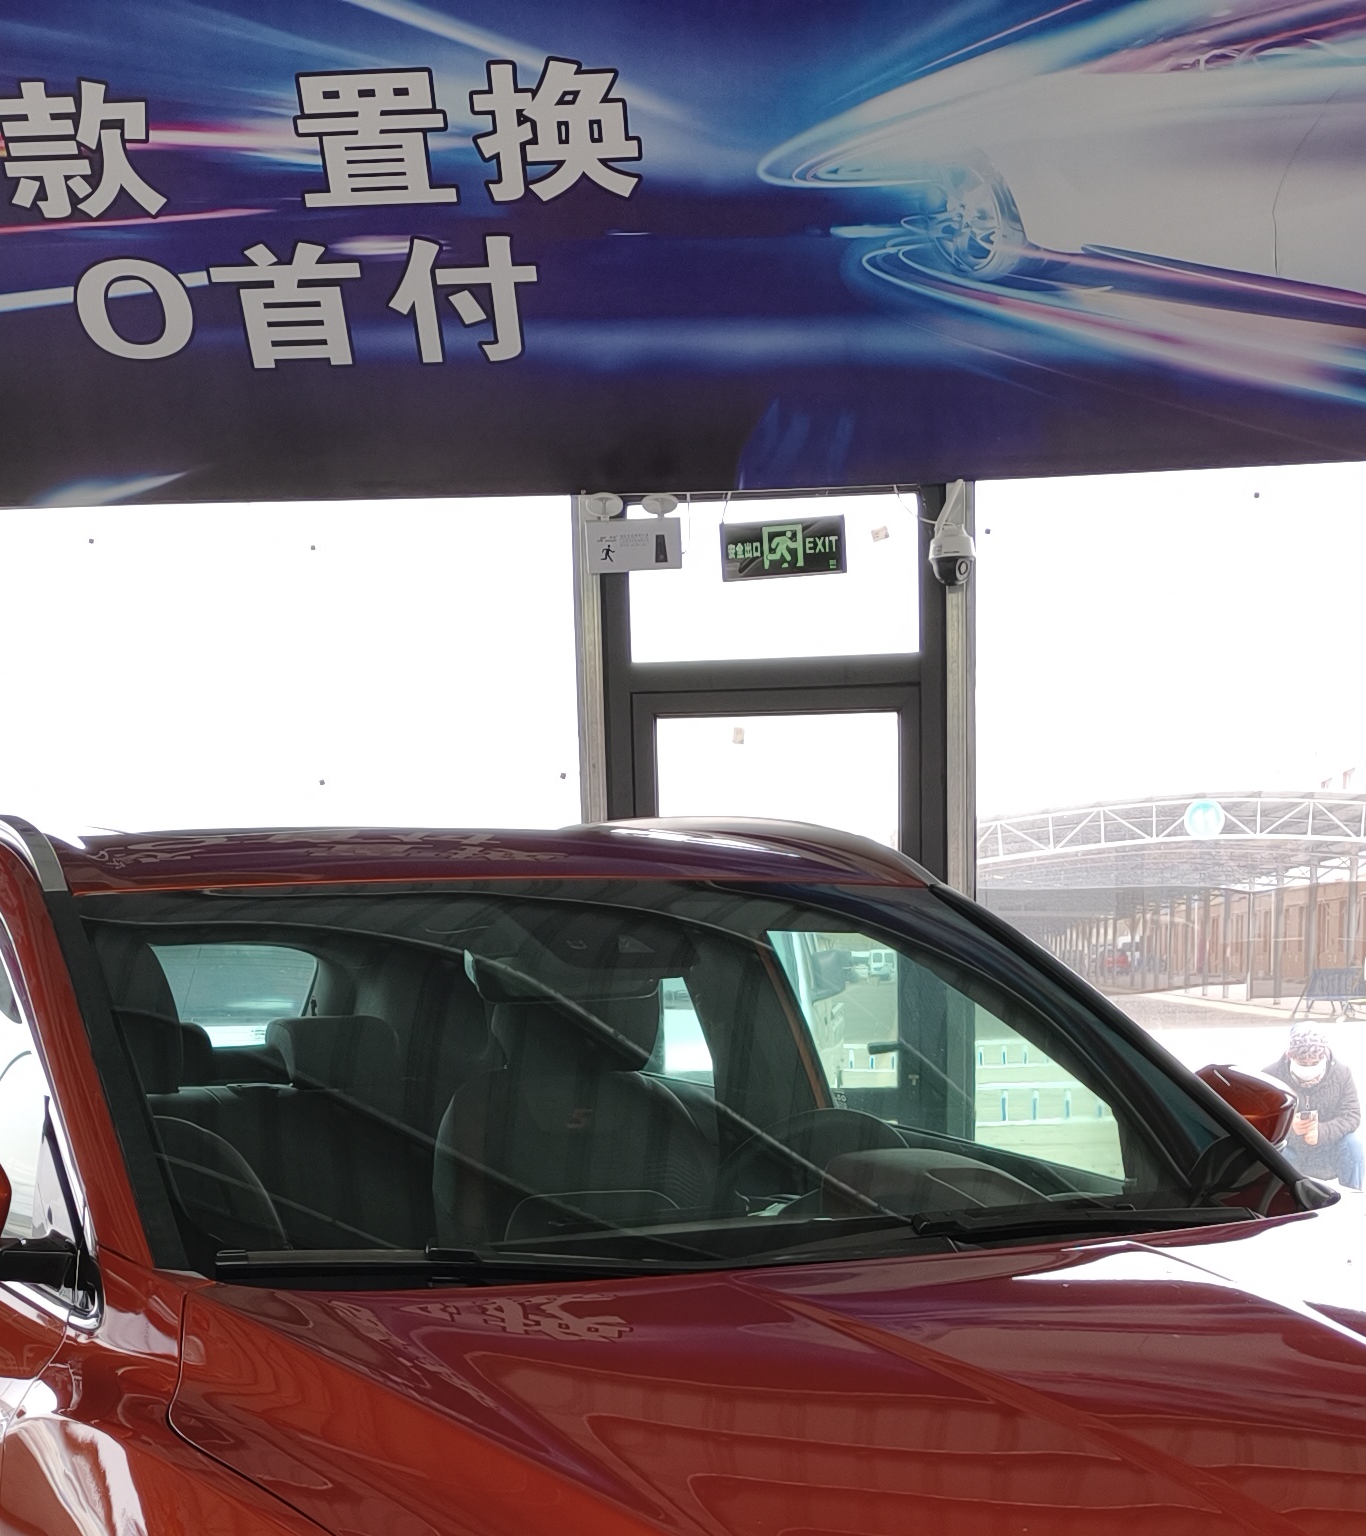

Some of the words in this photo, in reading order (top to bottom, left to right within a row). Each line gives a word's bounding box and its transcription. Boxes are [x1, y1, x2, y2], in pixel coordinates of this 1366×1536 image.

[294, 56, 642, 210] 置换
[727, 541, 761, 560] 安全出口
[805, 535, 839, 554] EXIT
